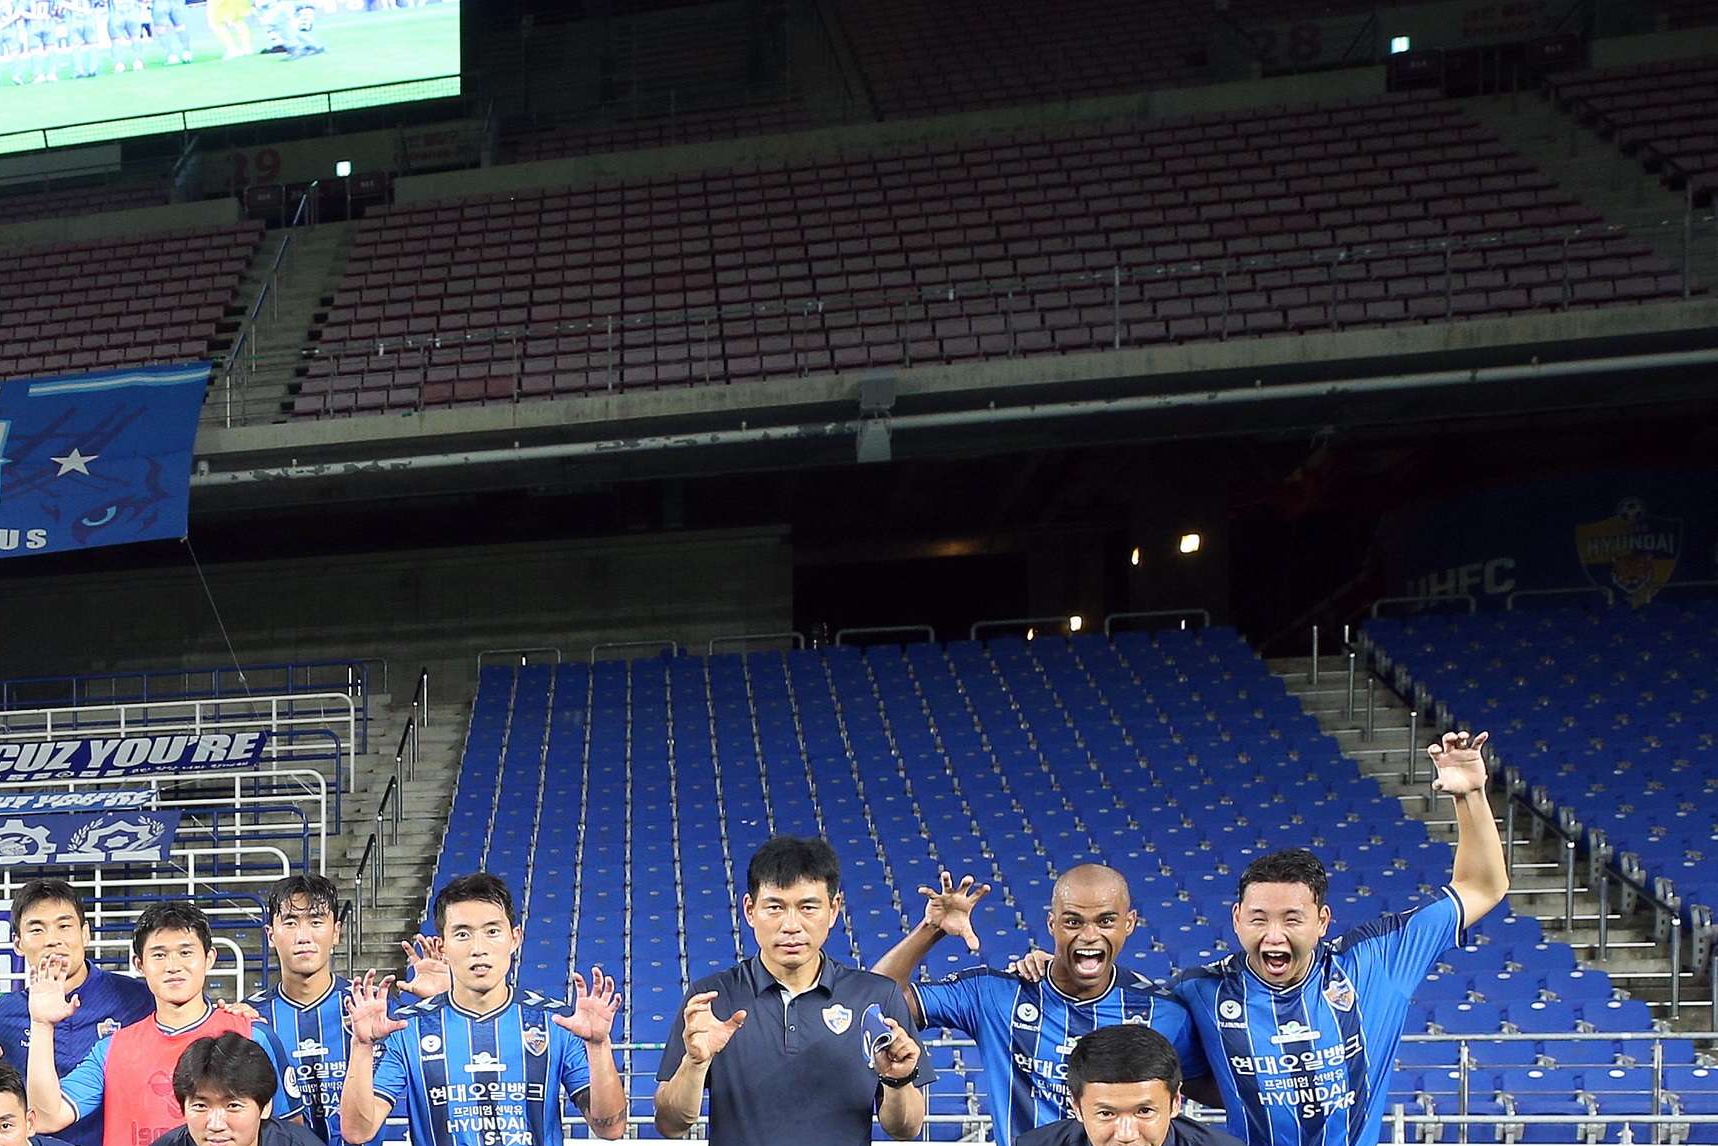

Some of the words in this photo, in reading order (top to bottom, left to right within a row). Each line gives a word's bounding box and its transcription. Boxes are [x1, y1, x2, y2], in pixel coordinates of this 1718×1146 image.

[88, 731, 260, 768] YOU'RE
[1231, 1034, 1363, 1075] 현대오일뱅크
[1264, 1075, 1309, 1090] 프리미엄
[1313, 1070, 1345, 1086] 선박유
[428, 1082, 544, 1107] 현대오일뱅크
[1258, 1082, 1347, 1107] HYUNDAI
[453, 1105, 493, 1117] 프리미엄
[494, 1104, 524, 1115] 선박유
[446, 1118, 525, 1134] HYUNDAI
